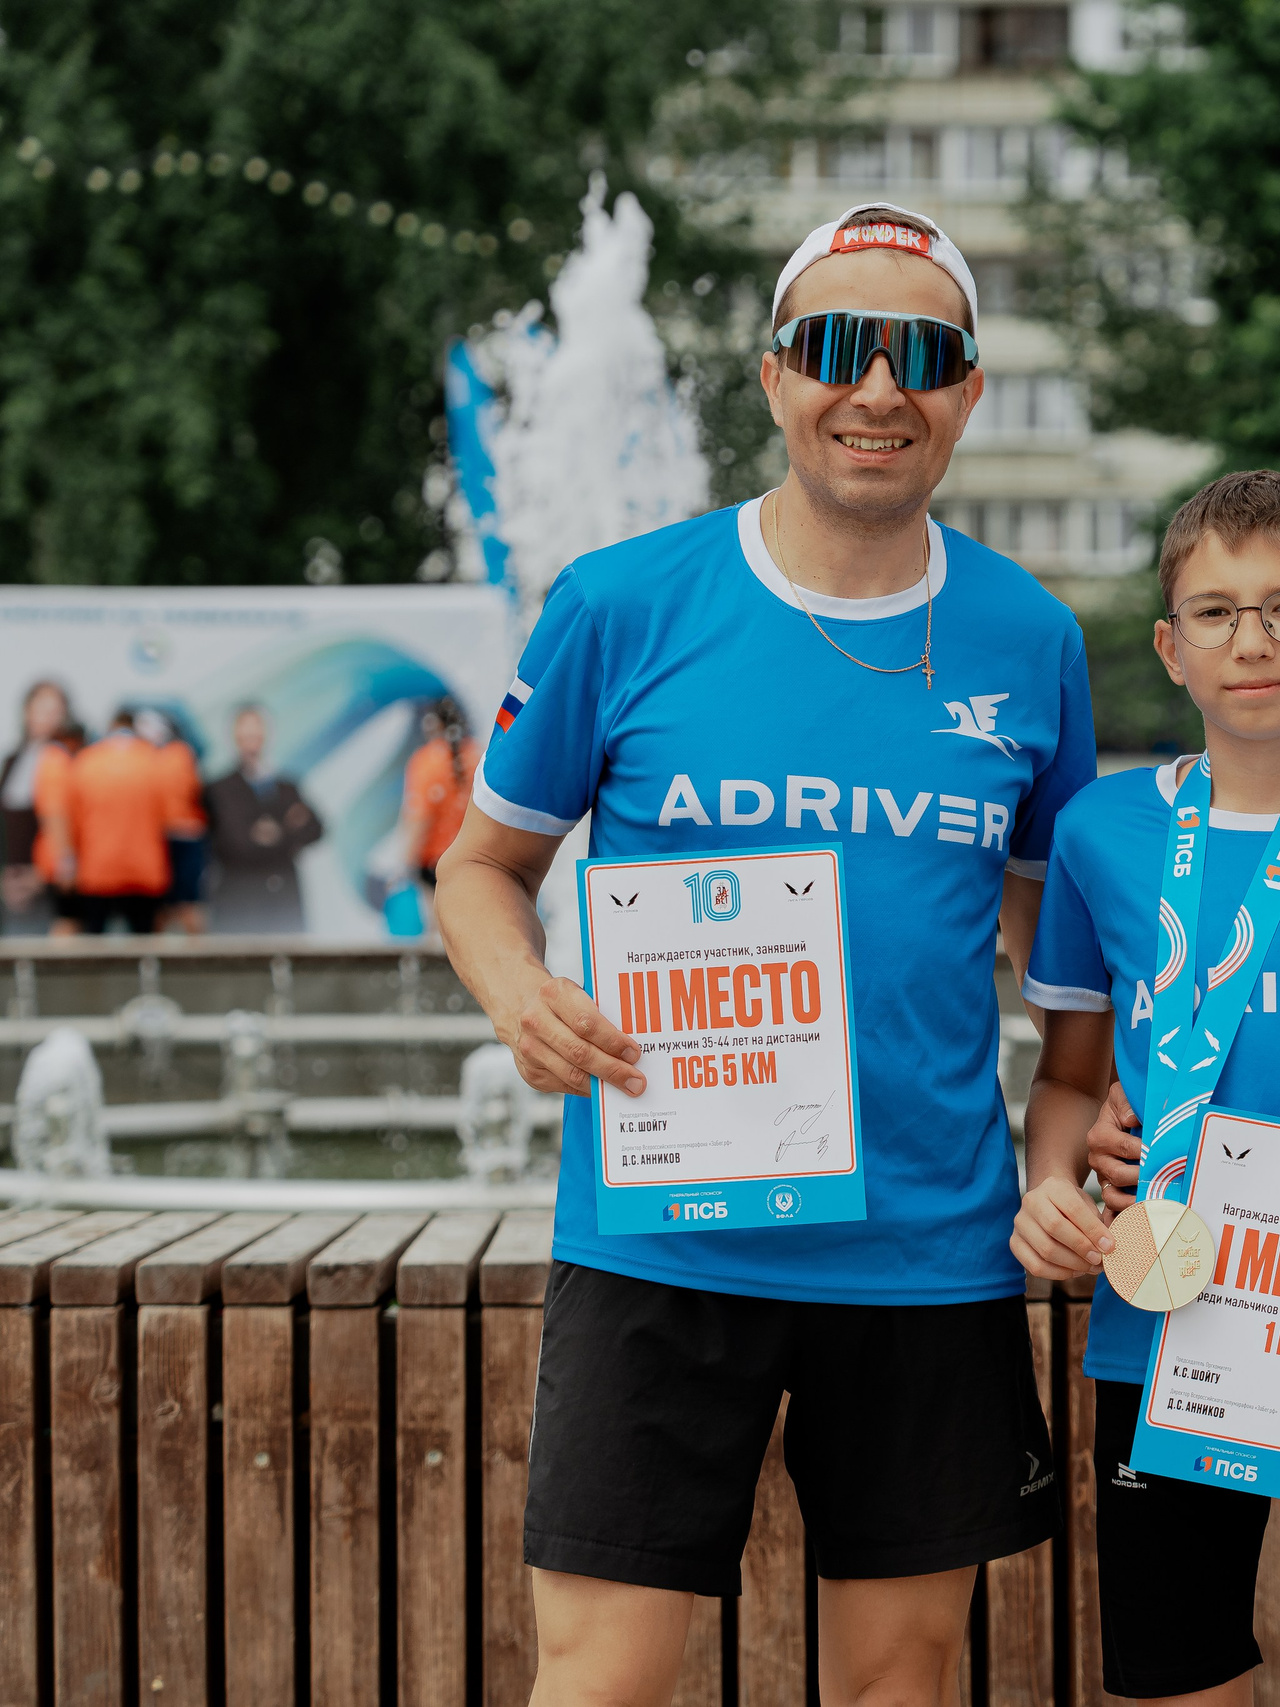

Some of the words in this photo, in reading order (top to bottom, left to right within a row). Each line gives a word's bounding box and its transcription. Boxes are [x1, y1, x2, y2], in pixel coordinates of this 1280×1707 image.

[843, 225, 921, 248] WONDER
[658, 774, 1009, 851] ADRIVER
[1173, 834, 1195, 878] ПСБ
[683, 869, 741, 923] 10
[627, 950, 701, 965] Награждается
[704, 947, 754, 961] участник,
[756, 940, 807, 955] занявший
[618, 971, 662, 1035] III
[669, 959, 822, 1031] МЕСТО
[659, 1038, 699, 1054] мужчин
[702, 1034, 730, 1049] 35-44
[732, 1036, 749, 1047] лет
[752, 1035, 763, 1046] на
[766, 1031, 820, 1047] дистанции
[672, 1054, 719, 1090] ПСБ
[722, 1053, 738, 1087] 5
[741, 1051, 777, 1085] КМ
[620, 1121, 637, 1133] К.С.
[638, 1118, 668, 1132] ШОЙГУ
[622, 1154, 640, 1167] Д.С.
[640, 1152, 681, 1166] АННИКОВ
[684, 1201, 728, 1220] ПСБ
[1213, 1223, 1235, 1286] I
[1195, 1292, 1223, 1305] реди
[1224, 1296, 1279, 1315] мальчиков
[1264, 1321, 1276, 1353] 1
[1173, 1365, 1189, 1379] К.С.
[1191, 1369, 1220, 1384] ШОЙГУ
[1167, 1398, 1184, 1411] Д.С.
[1185, 1401, 1225, 1419] АННИКОВ
[1214, 1459, 1258, 1482] ПСБ
[1020, 1472, 1054, 1497] DEMIX
[1111, 1478, 1147, 1489] NORDSKI
